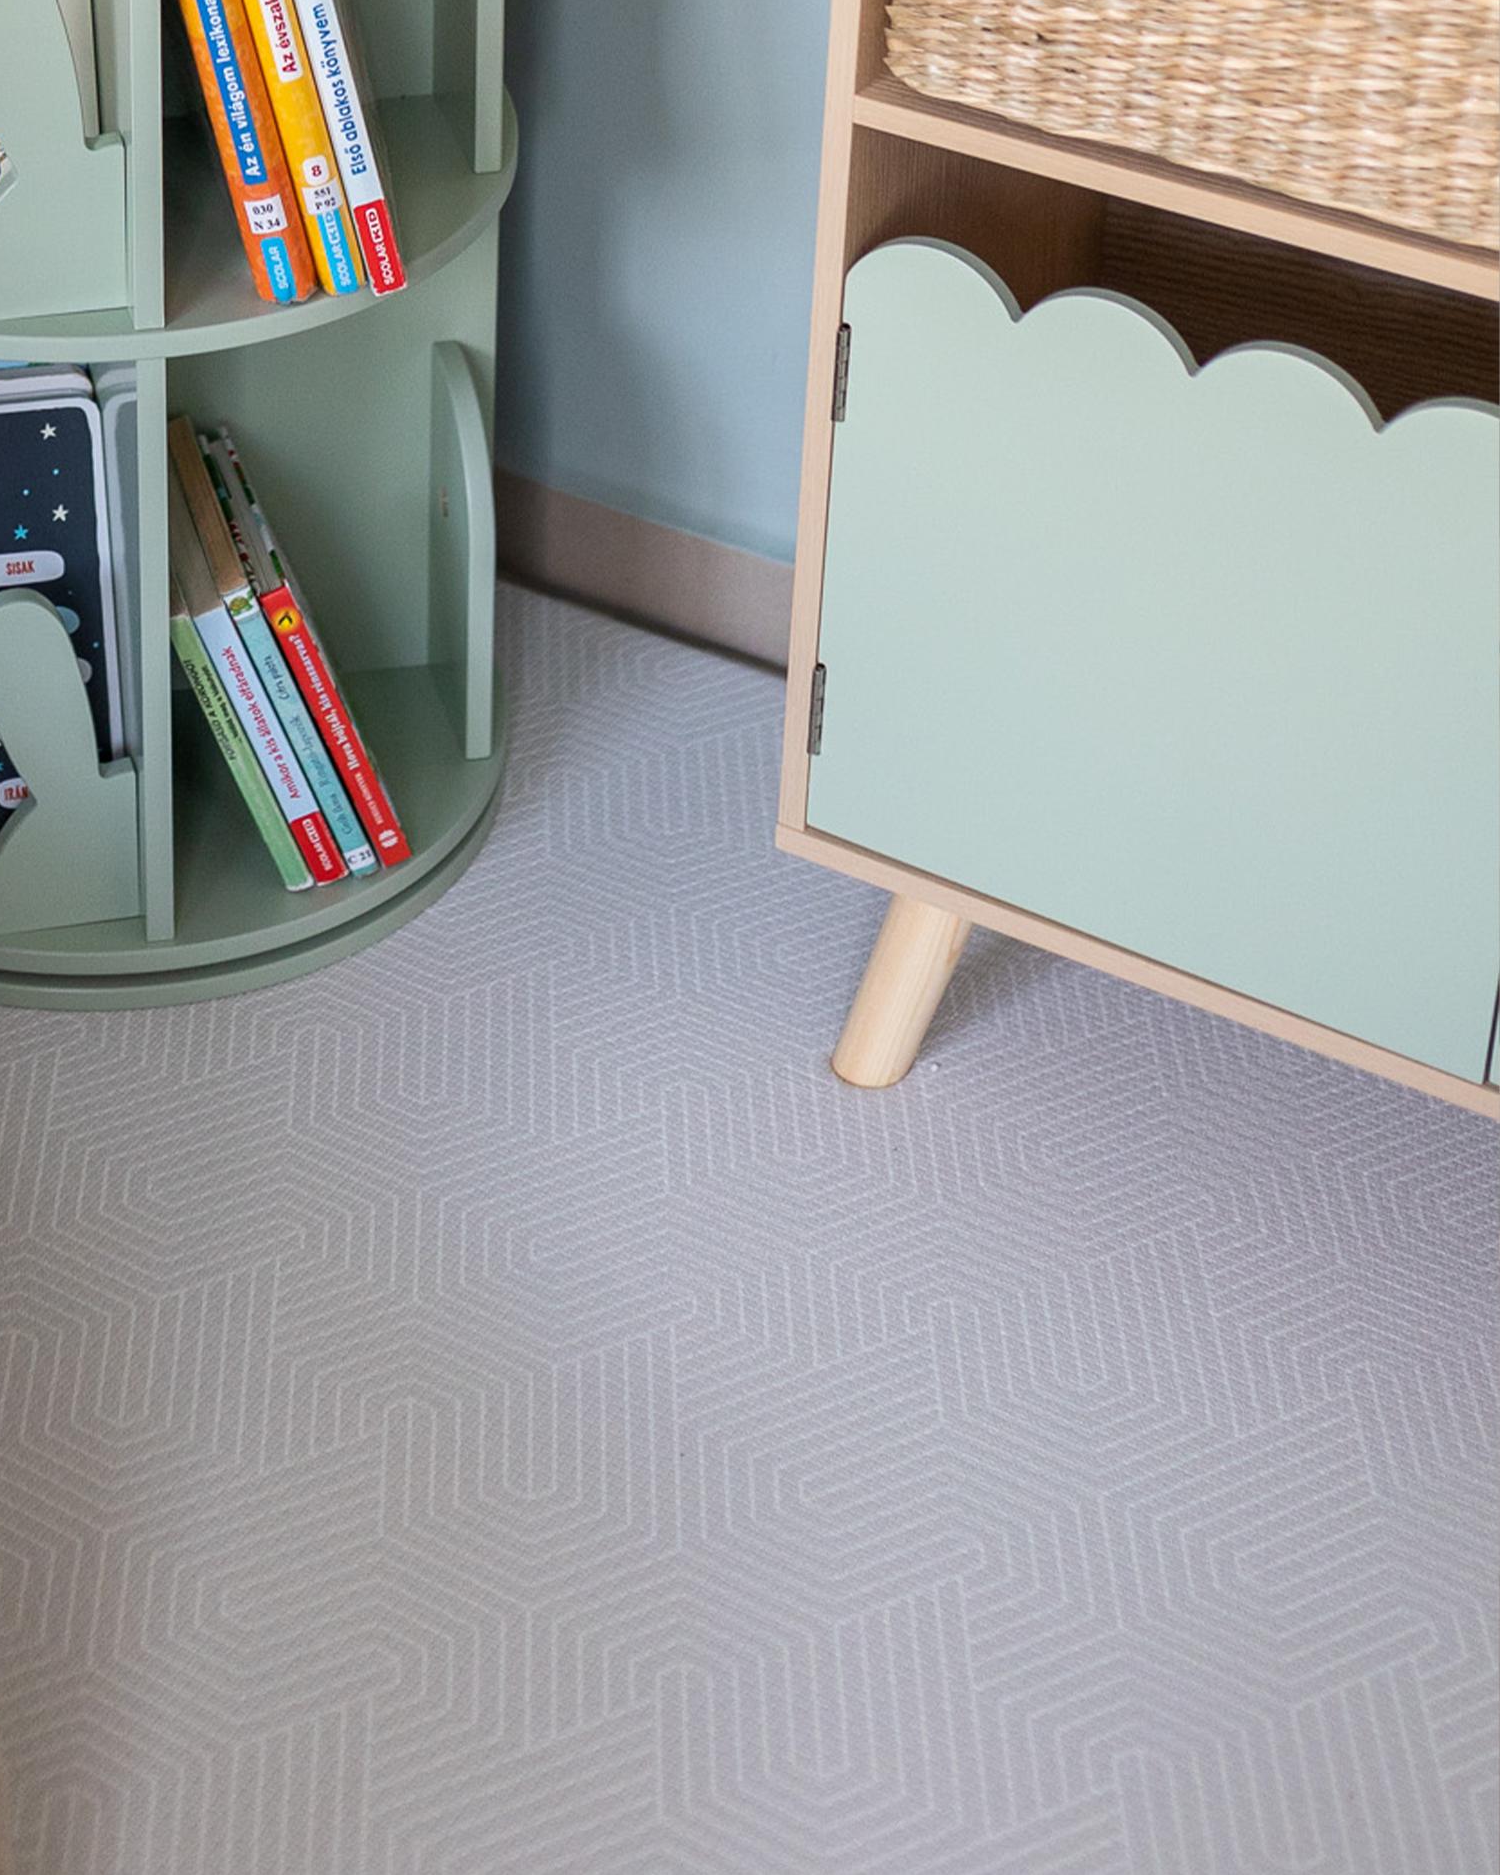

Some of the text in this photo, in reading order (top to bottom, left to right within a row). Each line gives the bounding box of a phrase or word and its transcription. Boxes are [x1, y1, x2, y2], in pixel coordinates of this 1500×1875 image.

[282, 53, 297, 73] Az
[223, 66, 248, 129] világom
[312, 3, 366, 175] Első ablakos könyvem
[238, 133, 254, 152] én
[245, 156, 261, 176] Az
[252, 203, 273, 215] 030
[267, 218, 280, 229] 34
[324, 210, 351, 286] SCOLAR KID
[368, 210, 394, 285] SCOLAR KID
[269, 246, 288, 288] SCOLAR
[5, 560, 35, 576] SISAK
[222, 646, 254, 701] elfáradnak
[317, 690, 332, 711] kis
[246, 701, 271, 738] állatok
[264, 736, 279, 755] kis
[341, 743, 360, 770] Hova
[276, 761, 301, 800] Amikor
[347, 848, 372, 866] C 21
